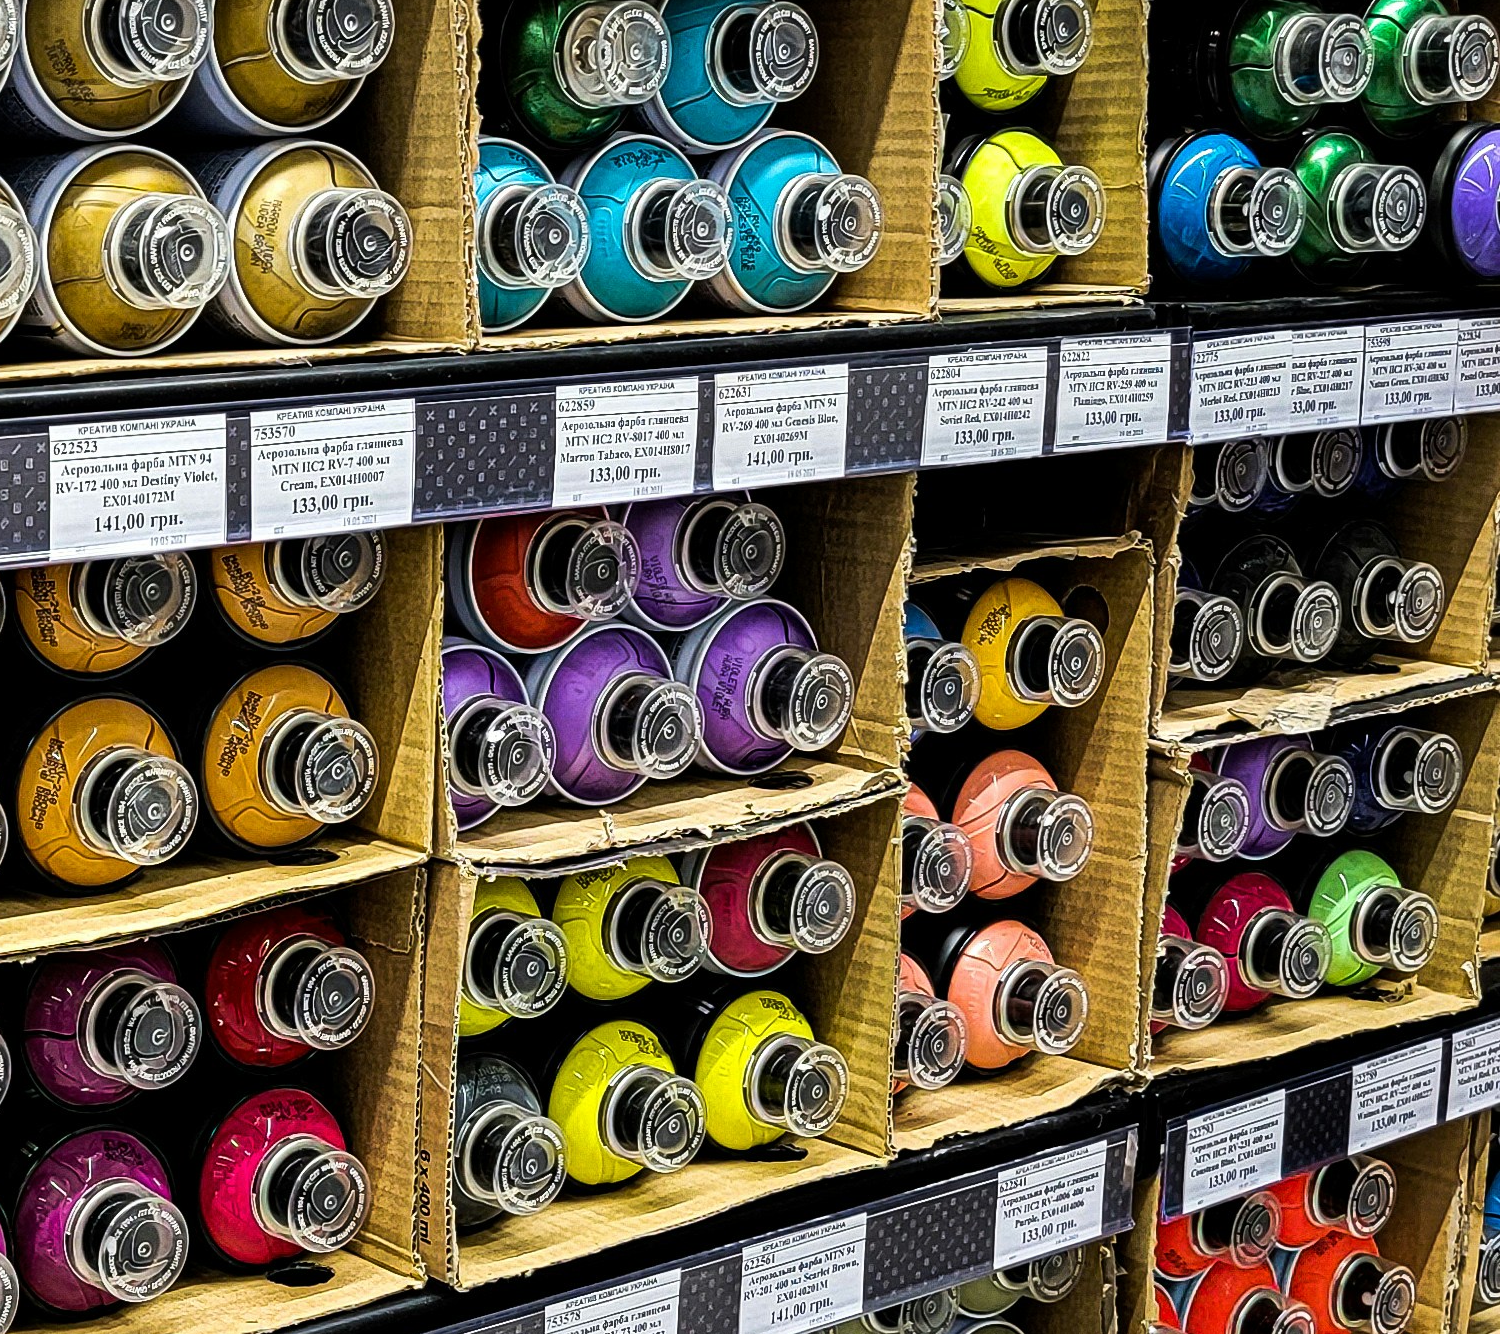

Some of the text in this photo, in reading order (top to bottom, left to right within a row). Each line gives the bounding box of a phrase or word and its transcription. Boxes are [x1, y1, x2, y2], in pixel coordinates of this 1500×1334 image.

[53, 440, 98, 456] 622523
[94, 512, 184, 534] 141,00 грн.
[419, 1149, 432, 1245] 6 x 400 ml
